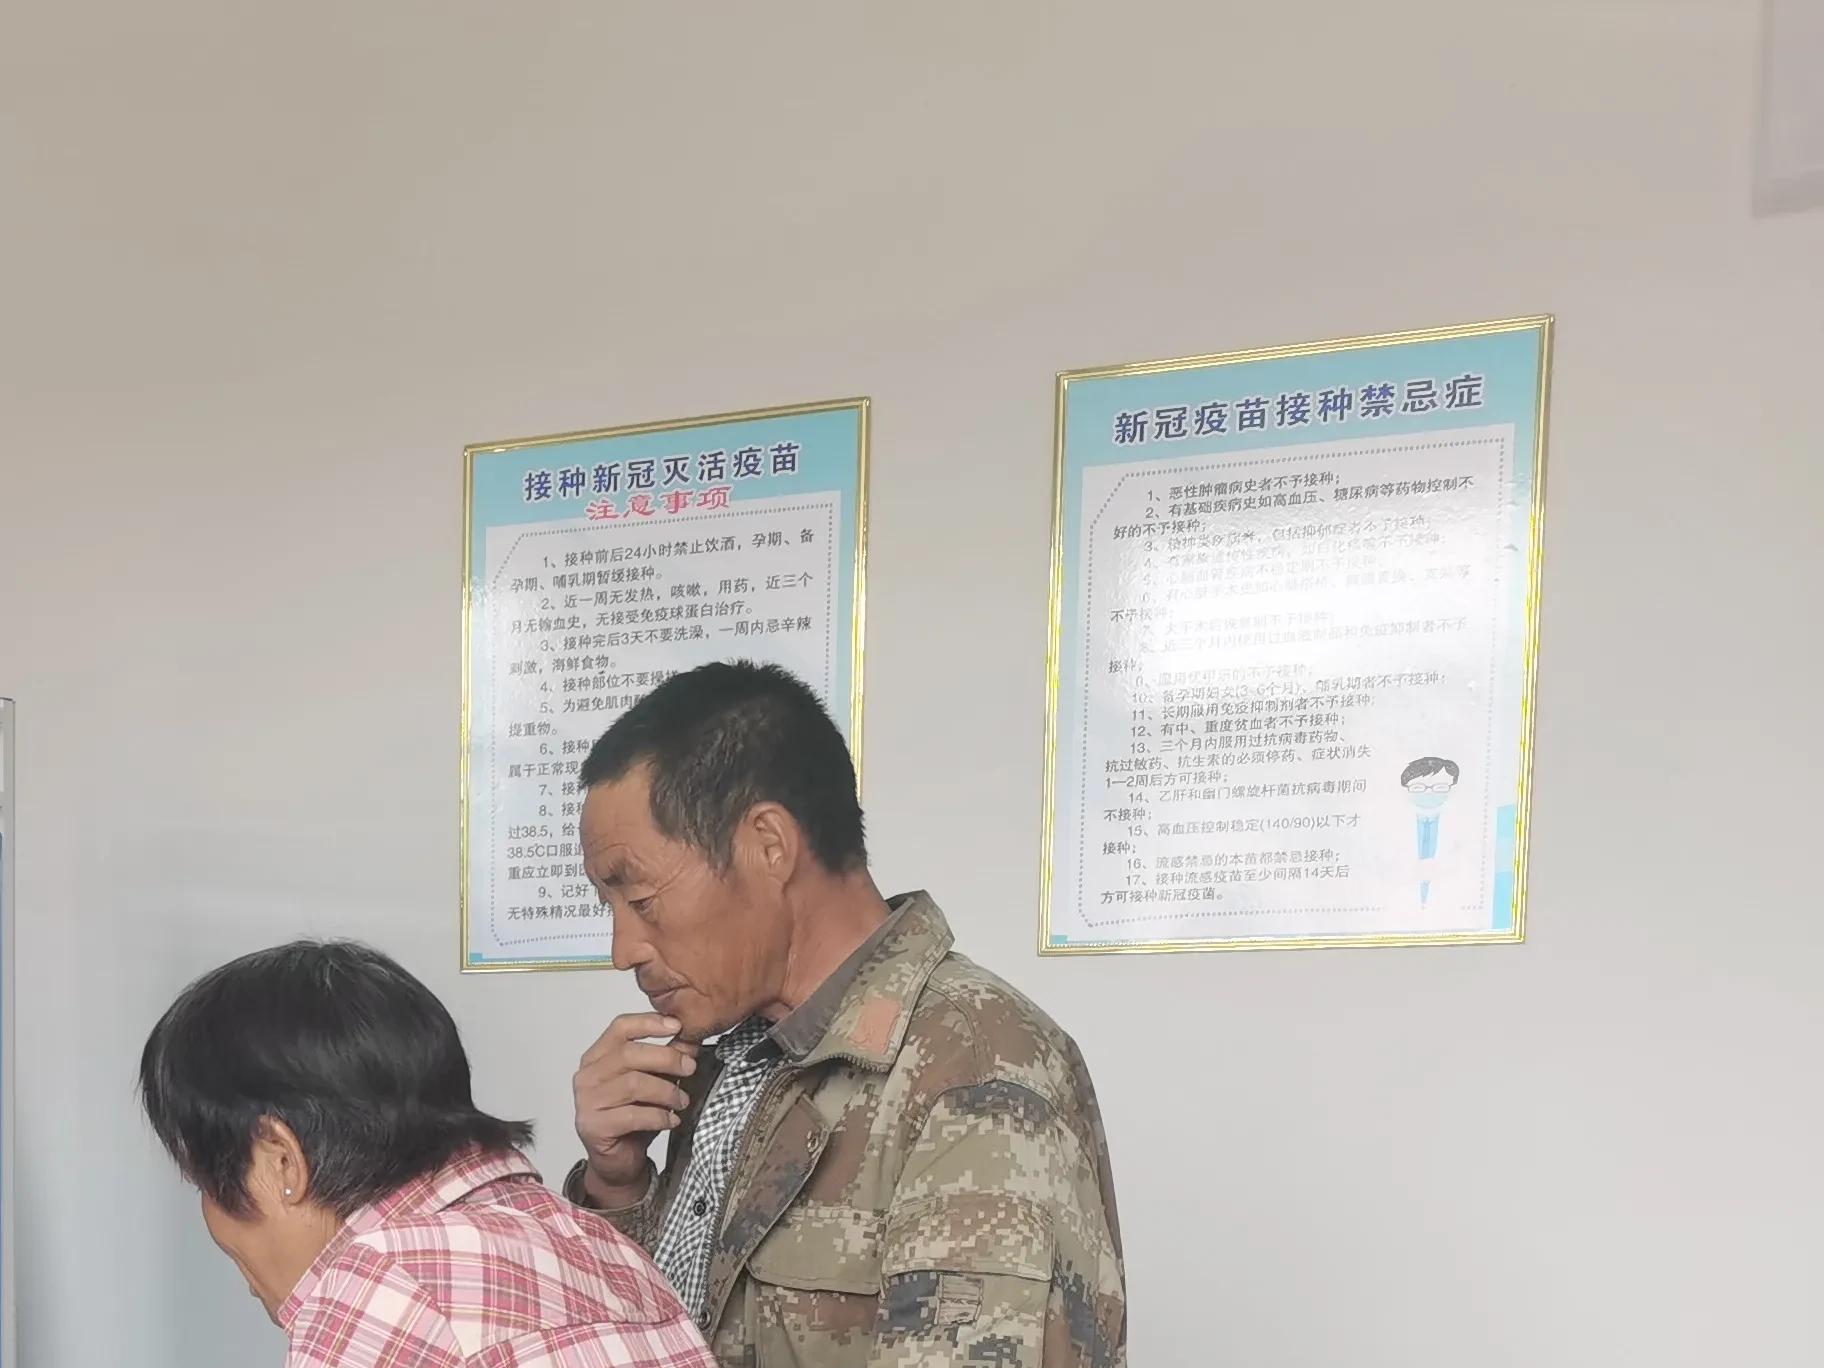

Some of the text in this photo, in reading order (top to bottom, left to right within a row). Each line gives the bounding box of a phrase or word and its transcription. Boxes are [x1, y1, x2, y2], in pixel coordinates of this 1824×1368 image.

[1112, 374, 1485, 445] 新冠疫苗接种禁忌症
[523, 442, 801, 502] 接种新冠灭活疫苗
[586, 486, 731, 521] 注意事项
[538, 738, 596, 756] 6、接种
[508, 821, 581, 840] 过38.5,给
